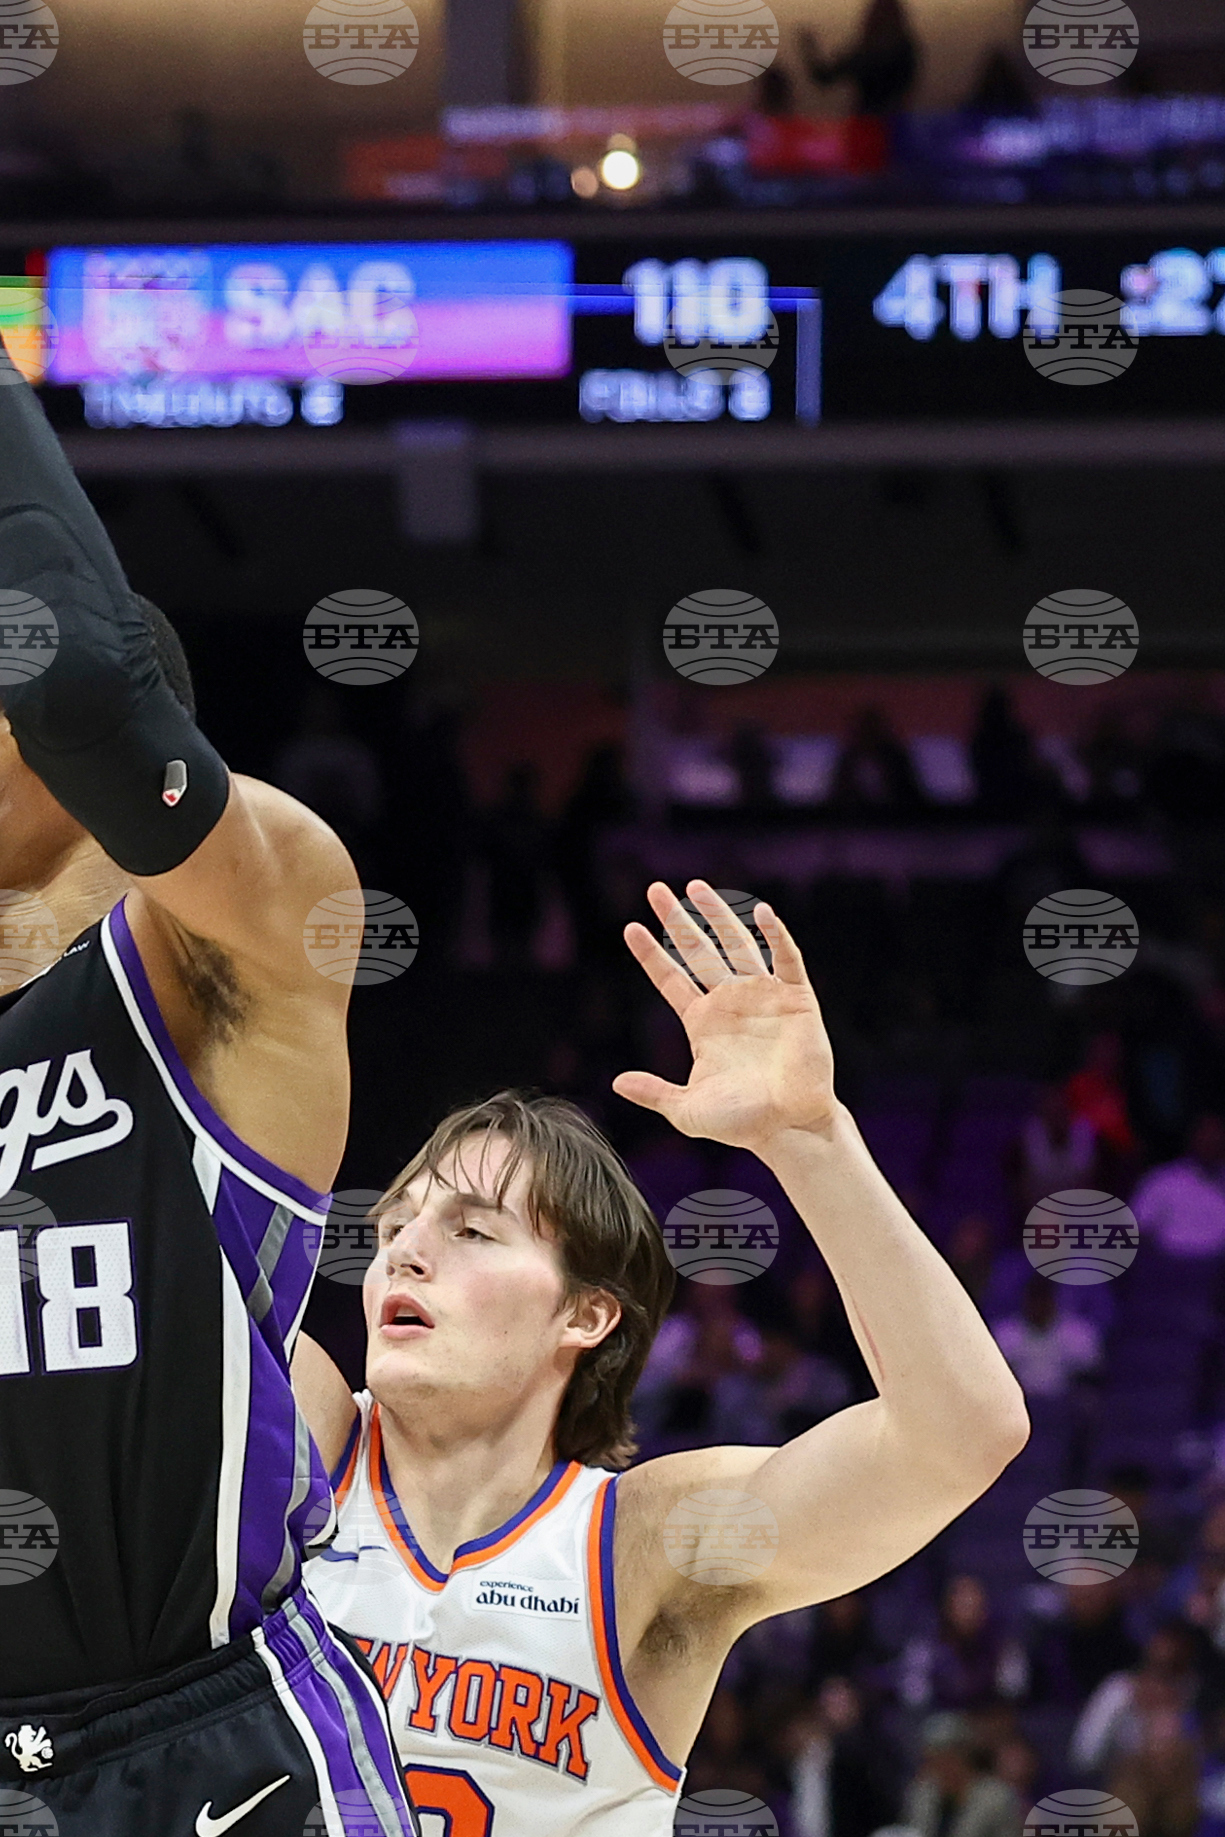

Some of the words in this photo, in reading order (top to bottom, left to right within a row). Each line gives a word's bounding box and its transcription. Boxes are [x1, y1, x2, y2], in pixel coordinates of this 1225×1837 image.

[222, 261, 415, 347] SAC
[623, 257, 770, 347] 110
[874, 253, 1062, 341] 4TH
[476, 1589, 516, 1607] abu
[520, 1595, 580, 1615] dhabi
[479, 1580, 534, 1593] experience
[407, 1644, 600, 1783] YORK
